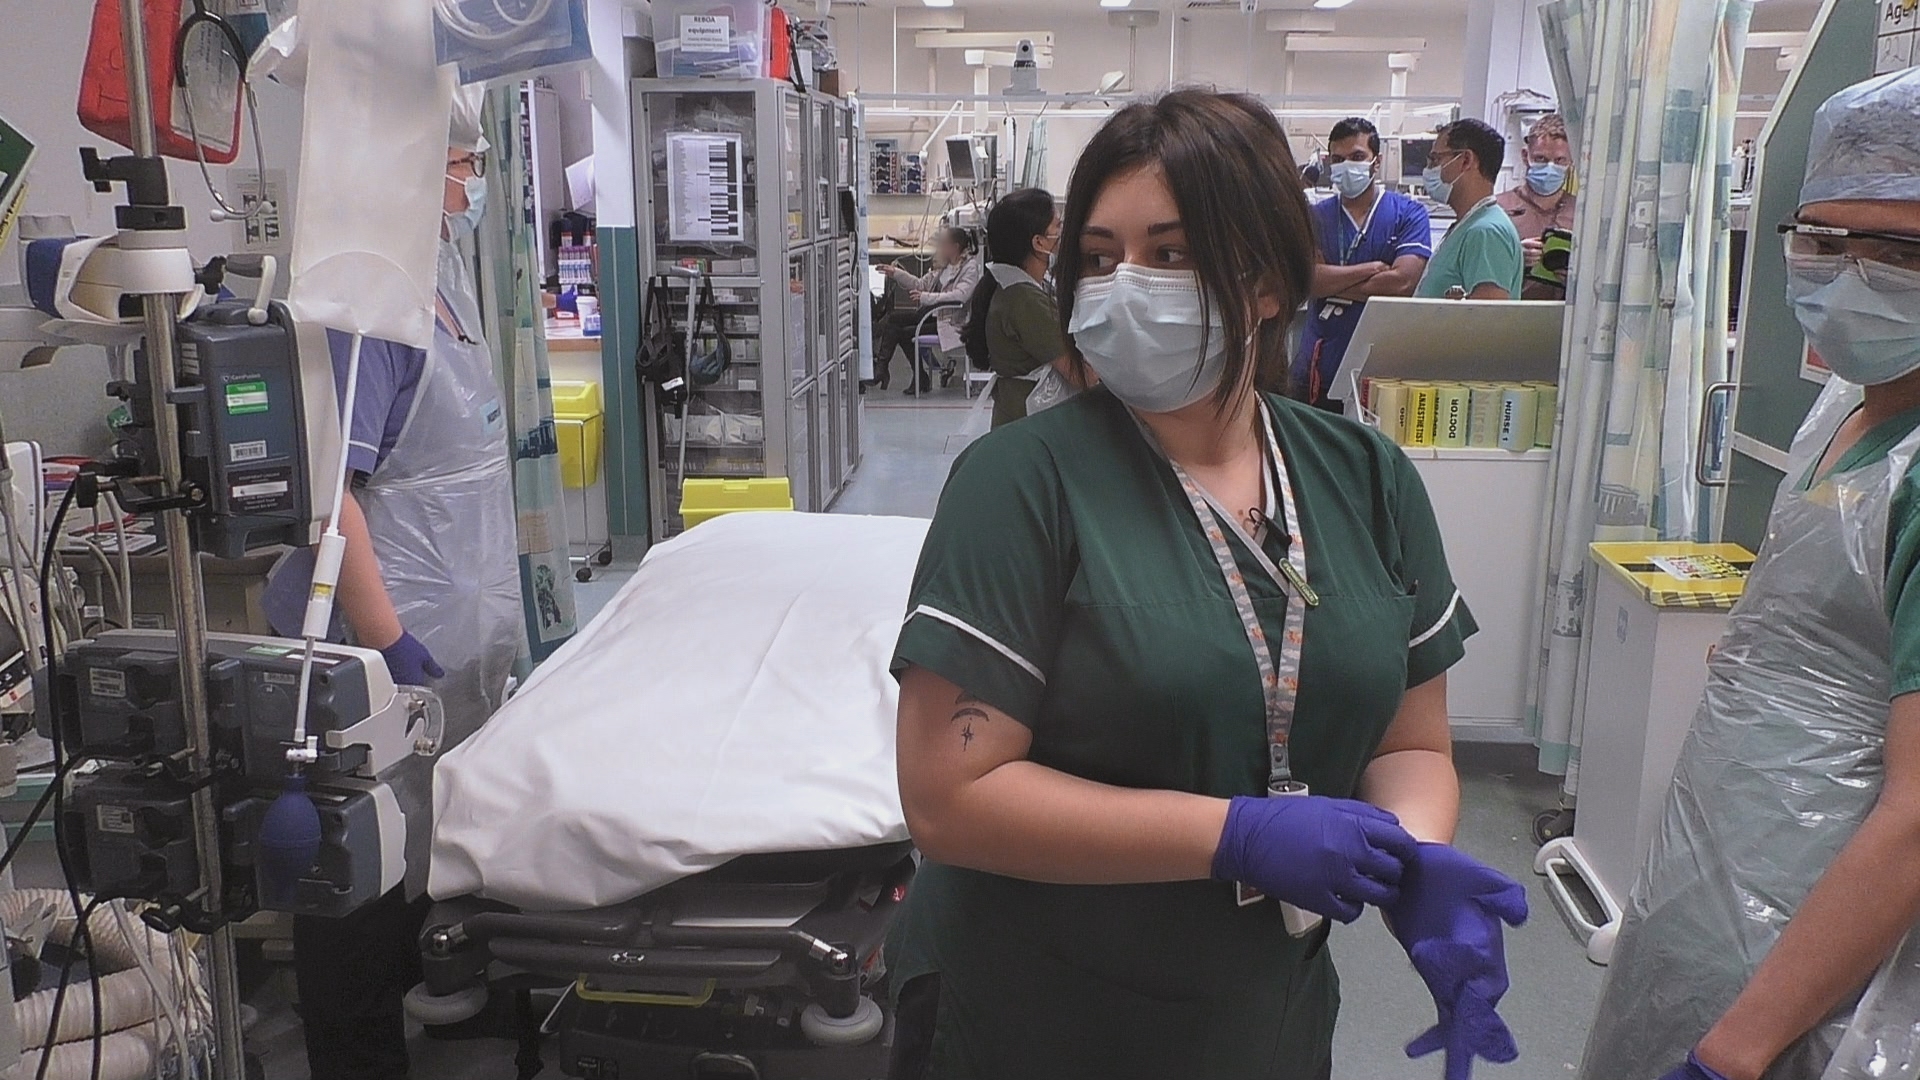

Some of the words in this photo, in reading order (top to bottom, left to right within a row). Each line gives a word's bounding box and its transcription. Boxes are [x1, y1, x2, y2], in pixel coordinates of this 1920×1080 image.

[1415, 392, 1427, 444] ANAESTHETIST
[1448, 398, 1460, 439] DOCTOR
[1475, 392, 1490, 444] Nurse
[1502, 400, 1513, 434] NURSE
